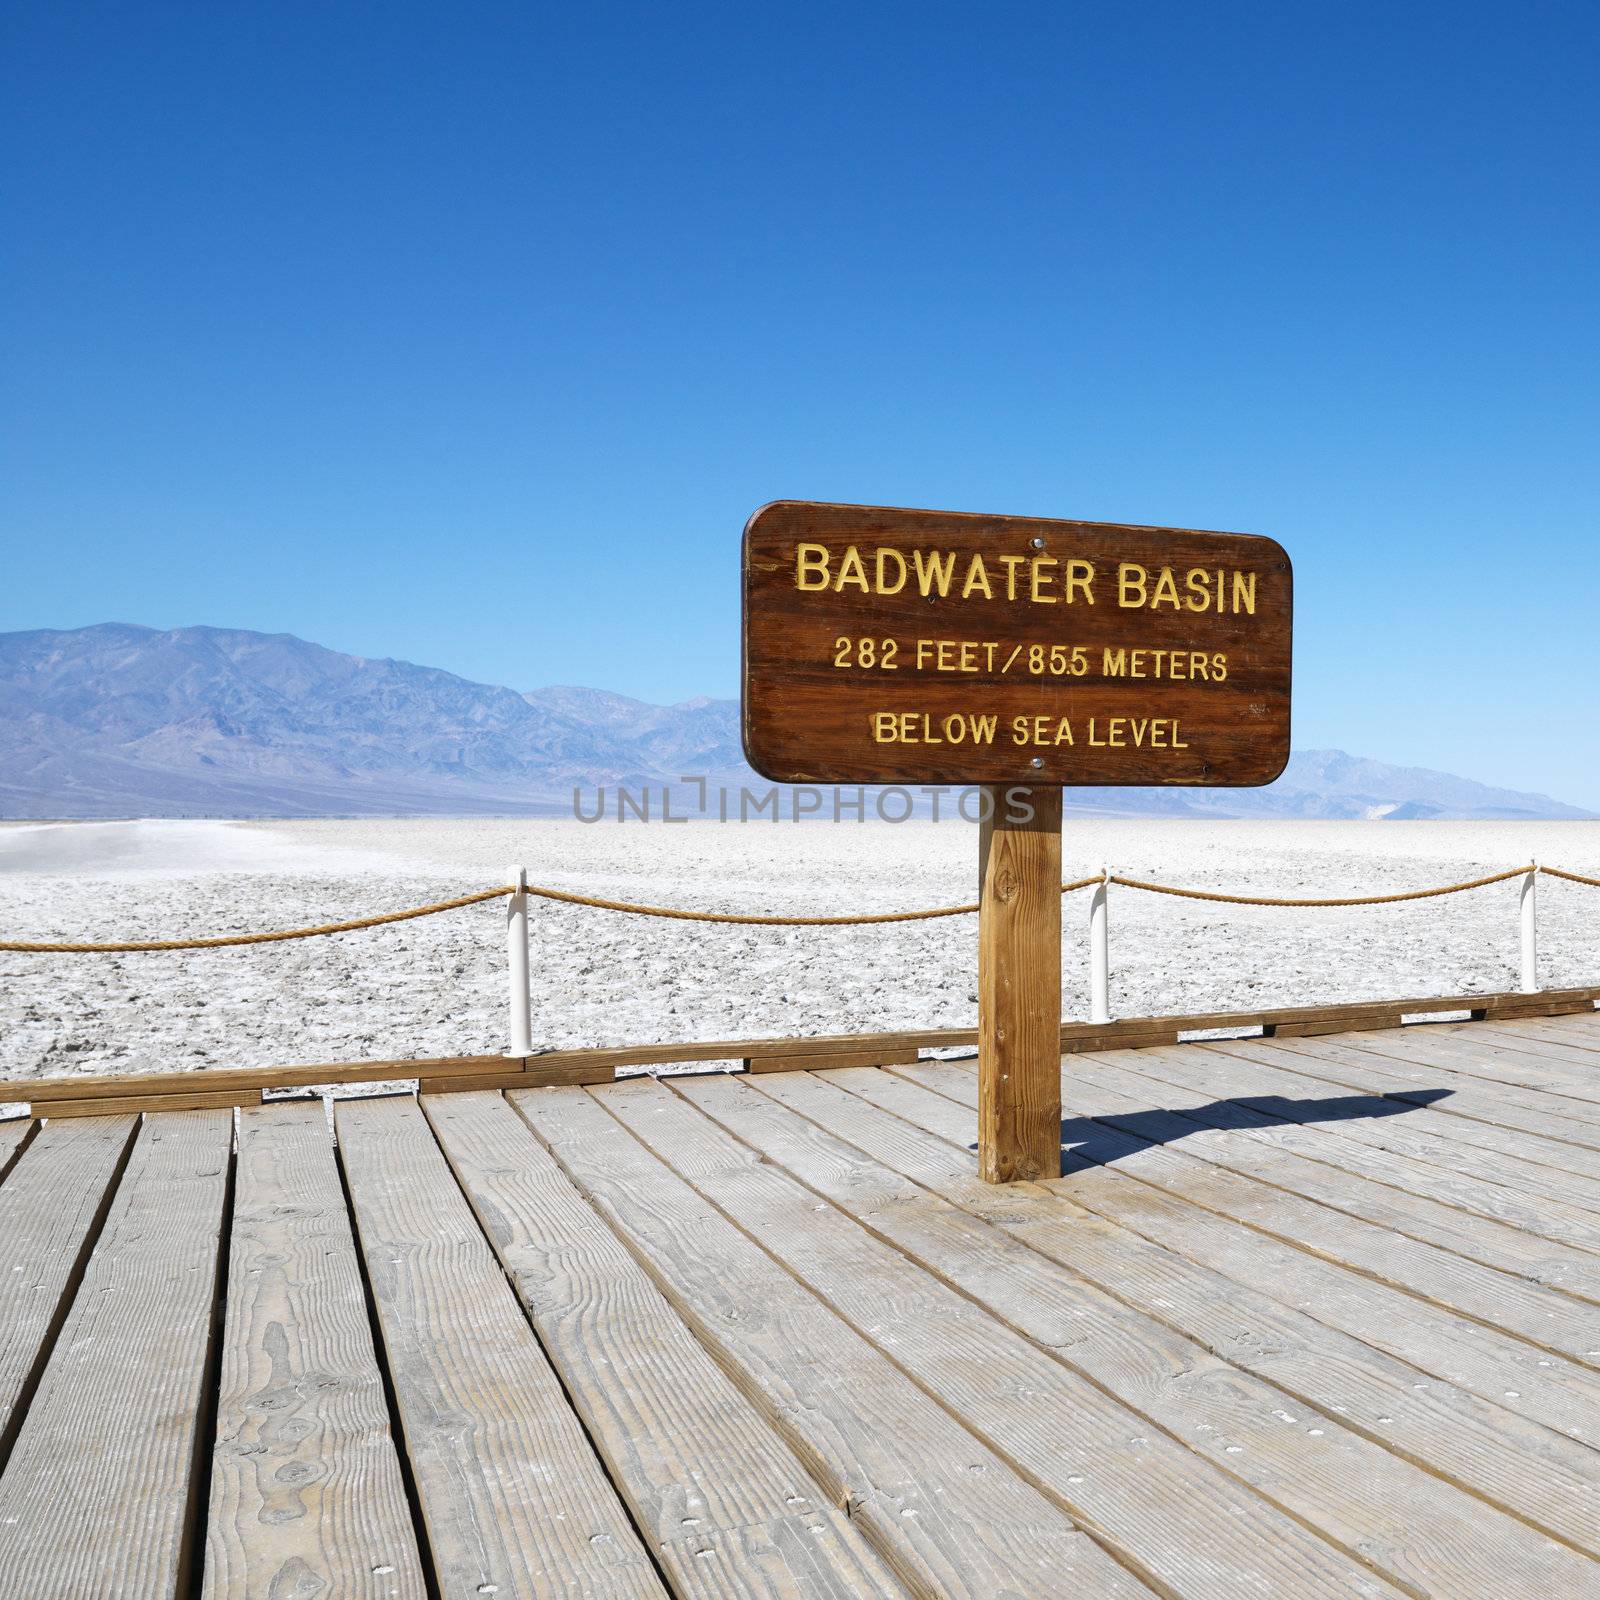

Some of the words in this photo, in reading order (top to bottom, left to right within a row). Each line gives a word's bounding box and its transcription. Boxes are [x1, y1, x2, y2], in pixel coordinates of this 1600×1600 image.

[797, 543, 1096, 604] BADWATER
[1118, 563, 1257, 614] BASIN
[834, 637, 899, 669] 282
[1103, 648, 1228, 682] METERS
[874, 712, 997, 745] BELOW
[1012, 716, 1074, 746] SEA
[1088, 718, 1189, 748] LEVEL
